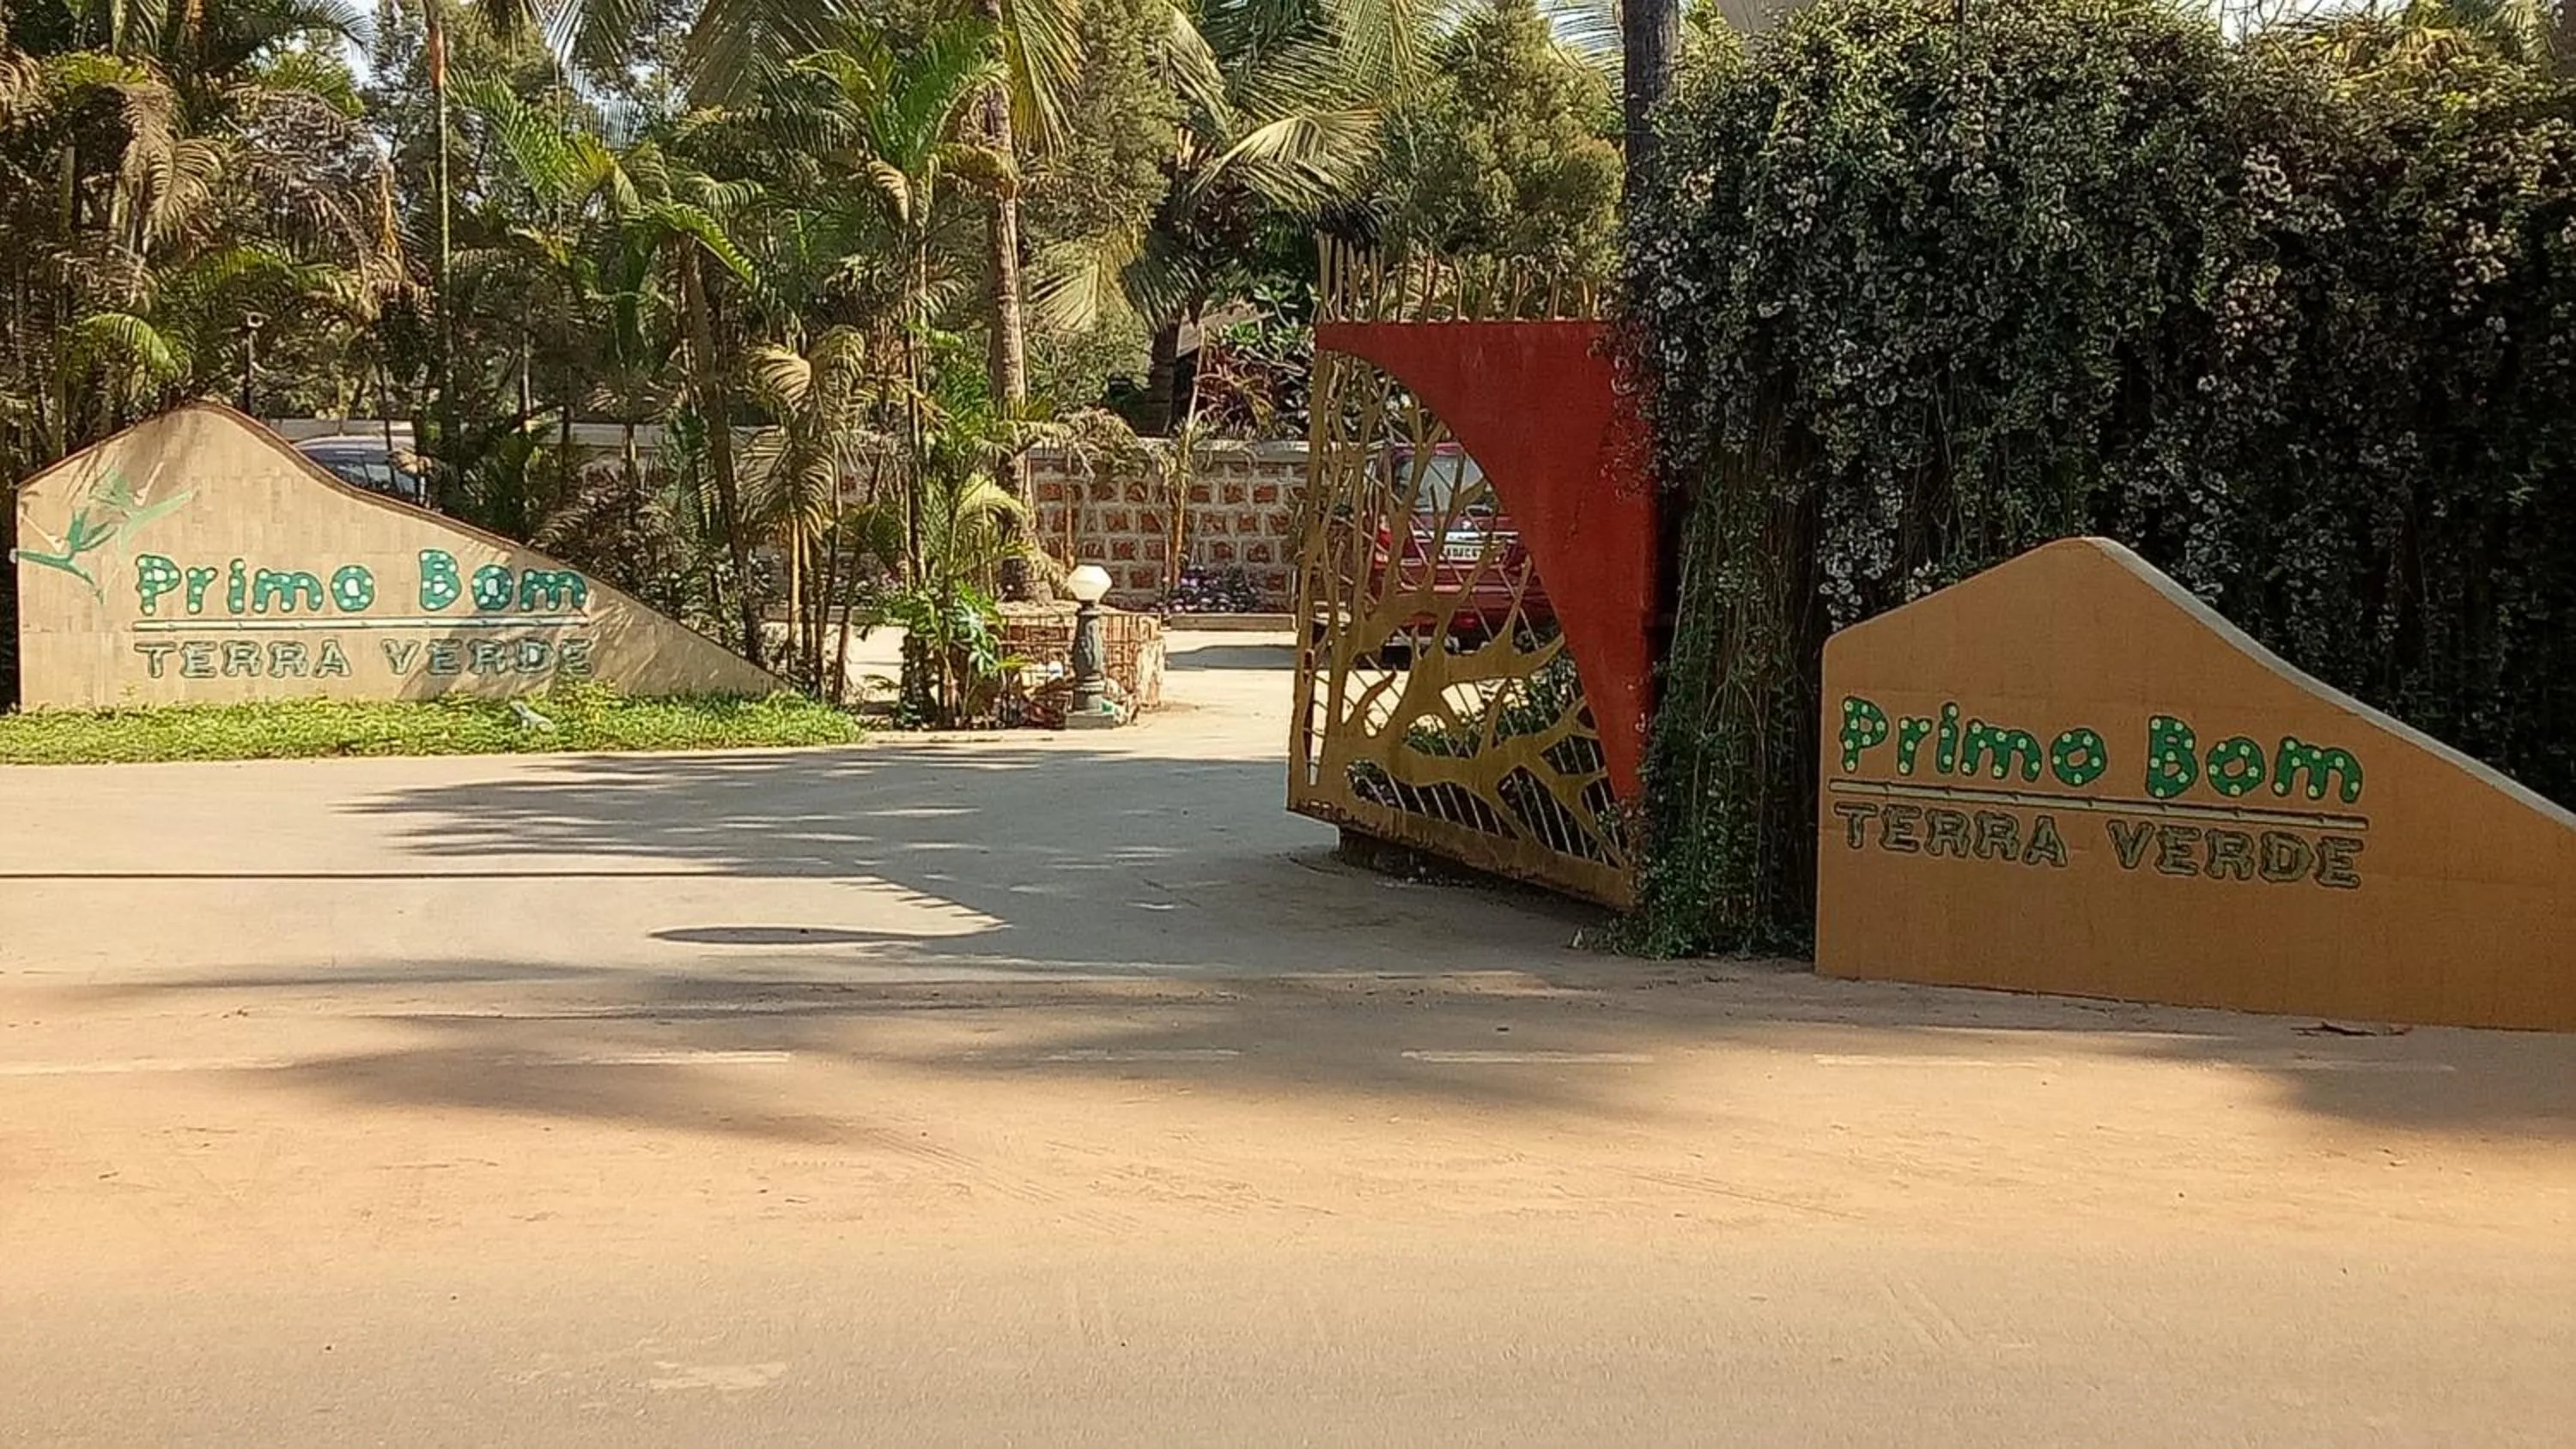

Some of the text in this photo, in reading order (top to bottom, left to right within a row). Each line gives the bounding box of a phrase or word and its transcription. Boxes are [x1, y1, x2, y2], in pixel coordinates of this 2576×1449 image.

[136, 549, 586, 615] Primo Bom
[134, 639, 594, 680] TERRA VERDE
[1839, 696, 2362, 803] Primo Bom
[1834, 801, 2364, 889] TERRA VERDE
